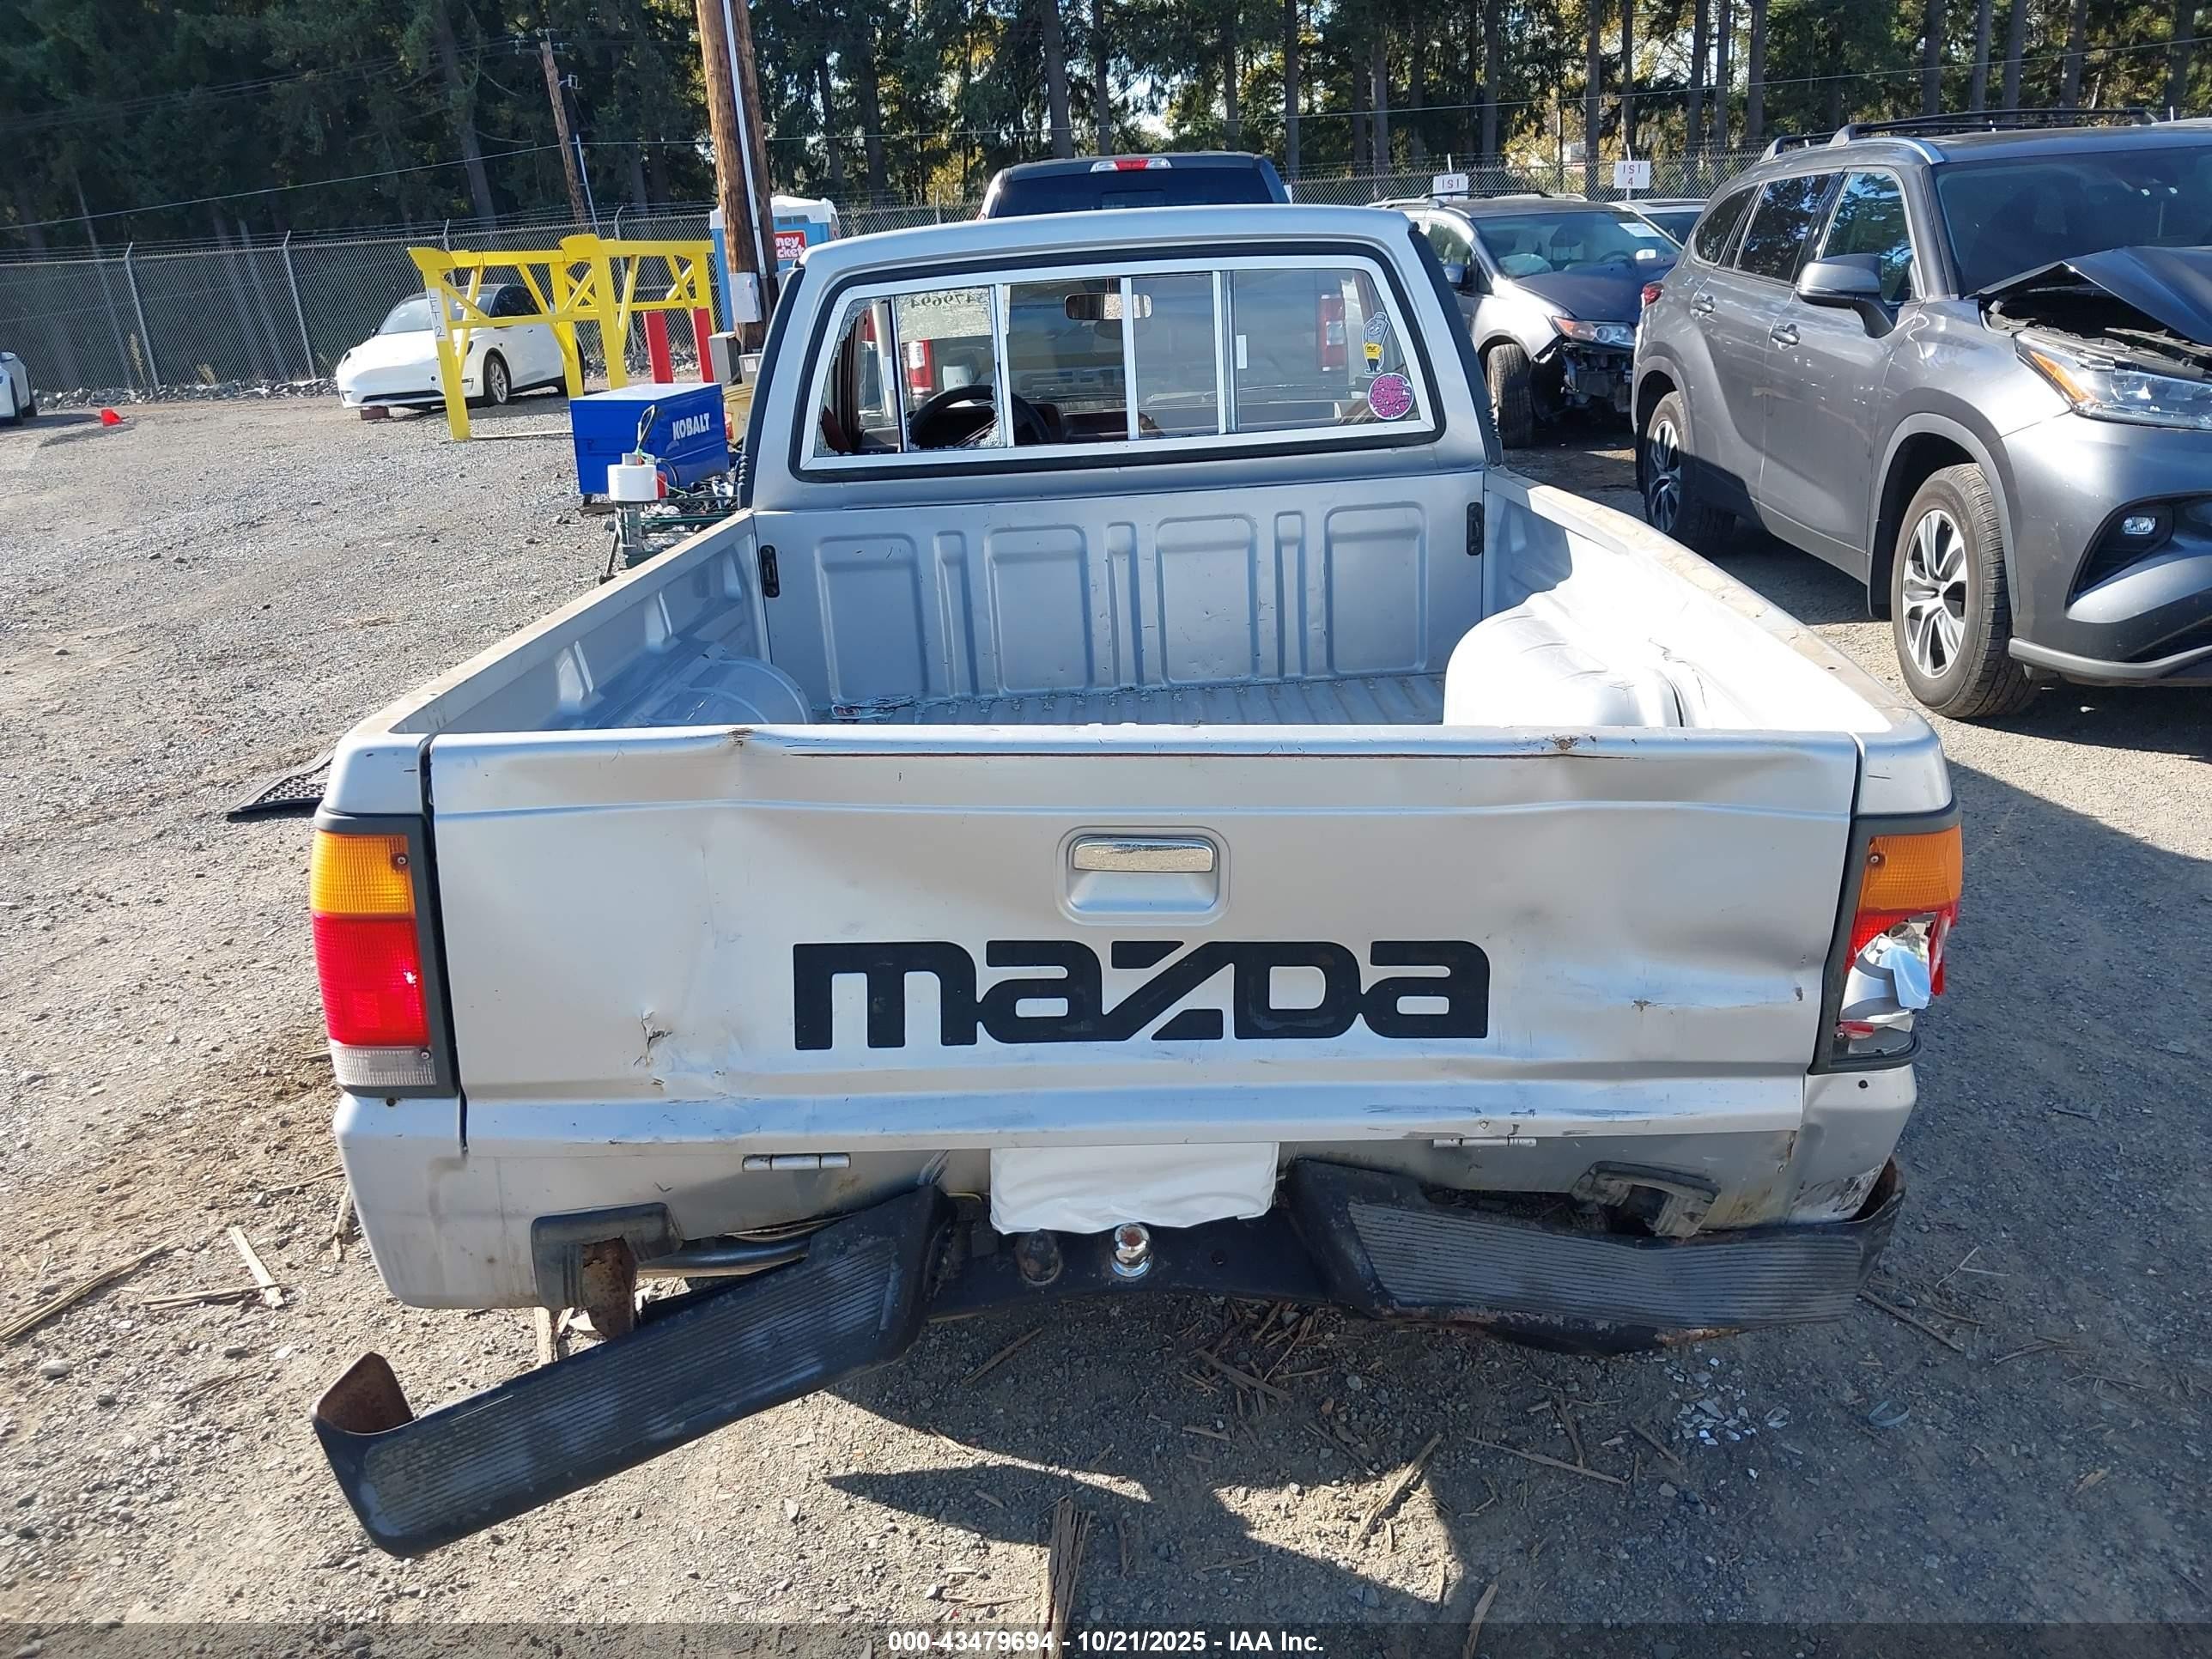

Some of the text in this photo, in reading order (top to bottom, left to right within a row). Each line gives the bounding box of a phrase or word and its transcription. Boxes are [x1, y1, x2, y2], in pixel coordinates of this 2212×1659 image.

[775, 236, 799, 248] ney
[776, 245, 804, 258] cket
[434, 325, 446, 337] 2
[672, 412, 710, 441] KOBALT
[793, 940, 1490, 1049] mazda
